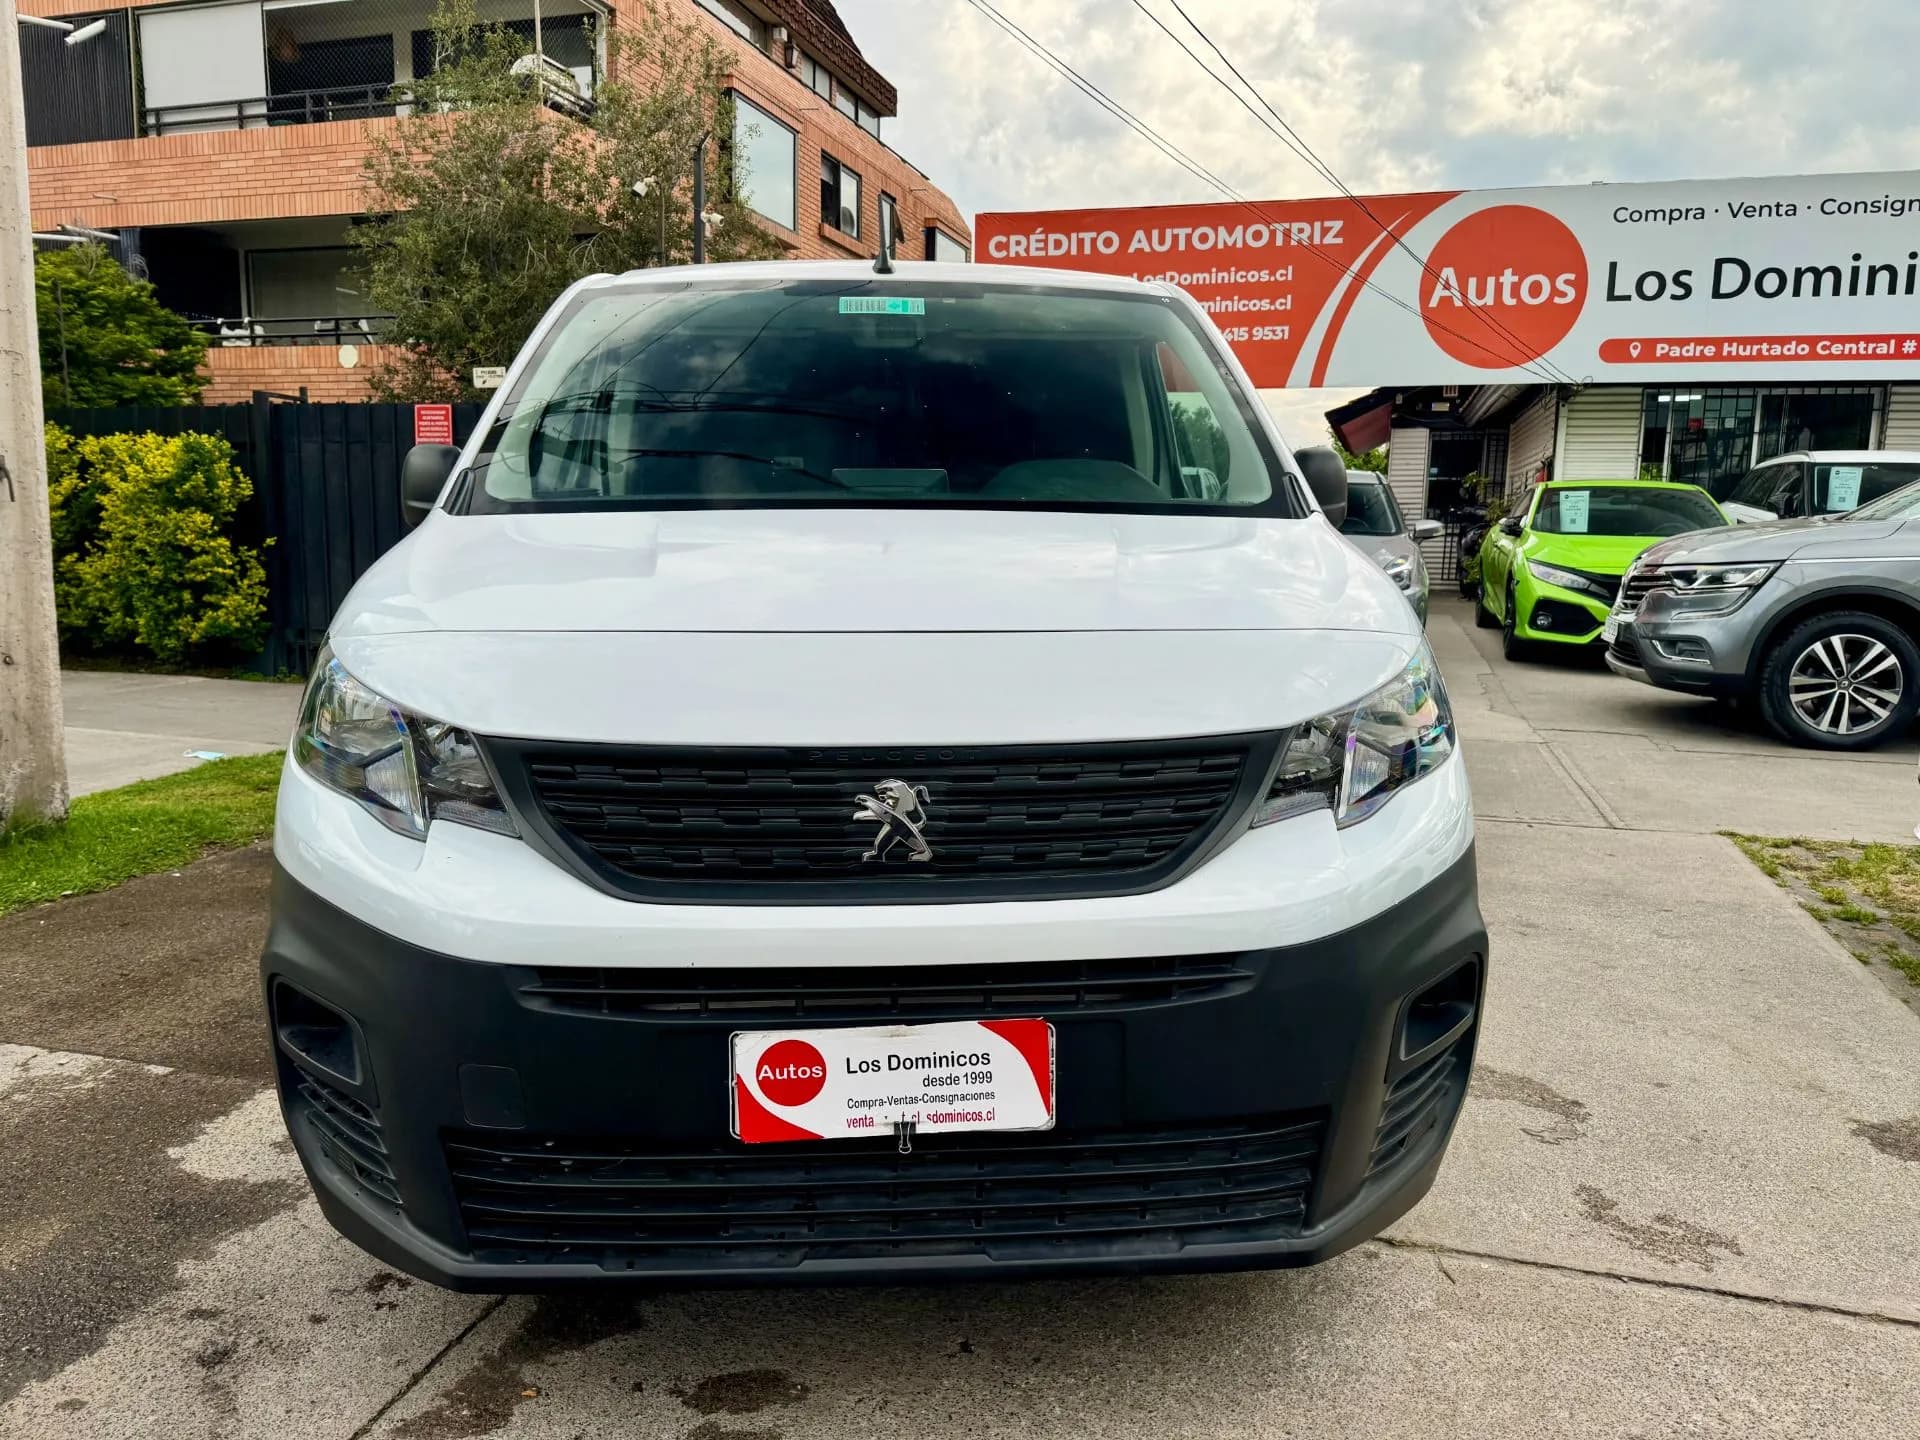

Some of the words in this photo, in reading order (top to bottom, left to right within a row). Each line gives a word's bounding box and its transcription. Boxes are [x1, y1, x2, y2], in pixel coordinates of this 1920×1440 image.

[1613, 205, 1706, 225] Compra
[1727, 200, 1798, 219] Venta
[988, 227, 1120, 259] CRÉDITO
[1128, 220, 1344, 254] AUTOMOTRIZ
[1429, 266, 1577, 308] Autos
[1606, 261, 1693, 302] Los
[1711, 251, 1918, 300] Domini
[1253, 326, 1289, 341] 9531
[1655, 342, 1716, 357] Padre
[1722, 340, 1809, 356] Hurtado
[1816, 338, 1895, 355] Central
[758, 1063, 823, 1081] Autos
[845, 1056, 881, 1075] Los
[887, 1051, 991, 1071] Dominicos
[922, 1073, 960, 1088] desde
[963, 1071, 993, 1085] 1999
